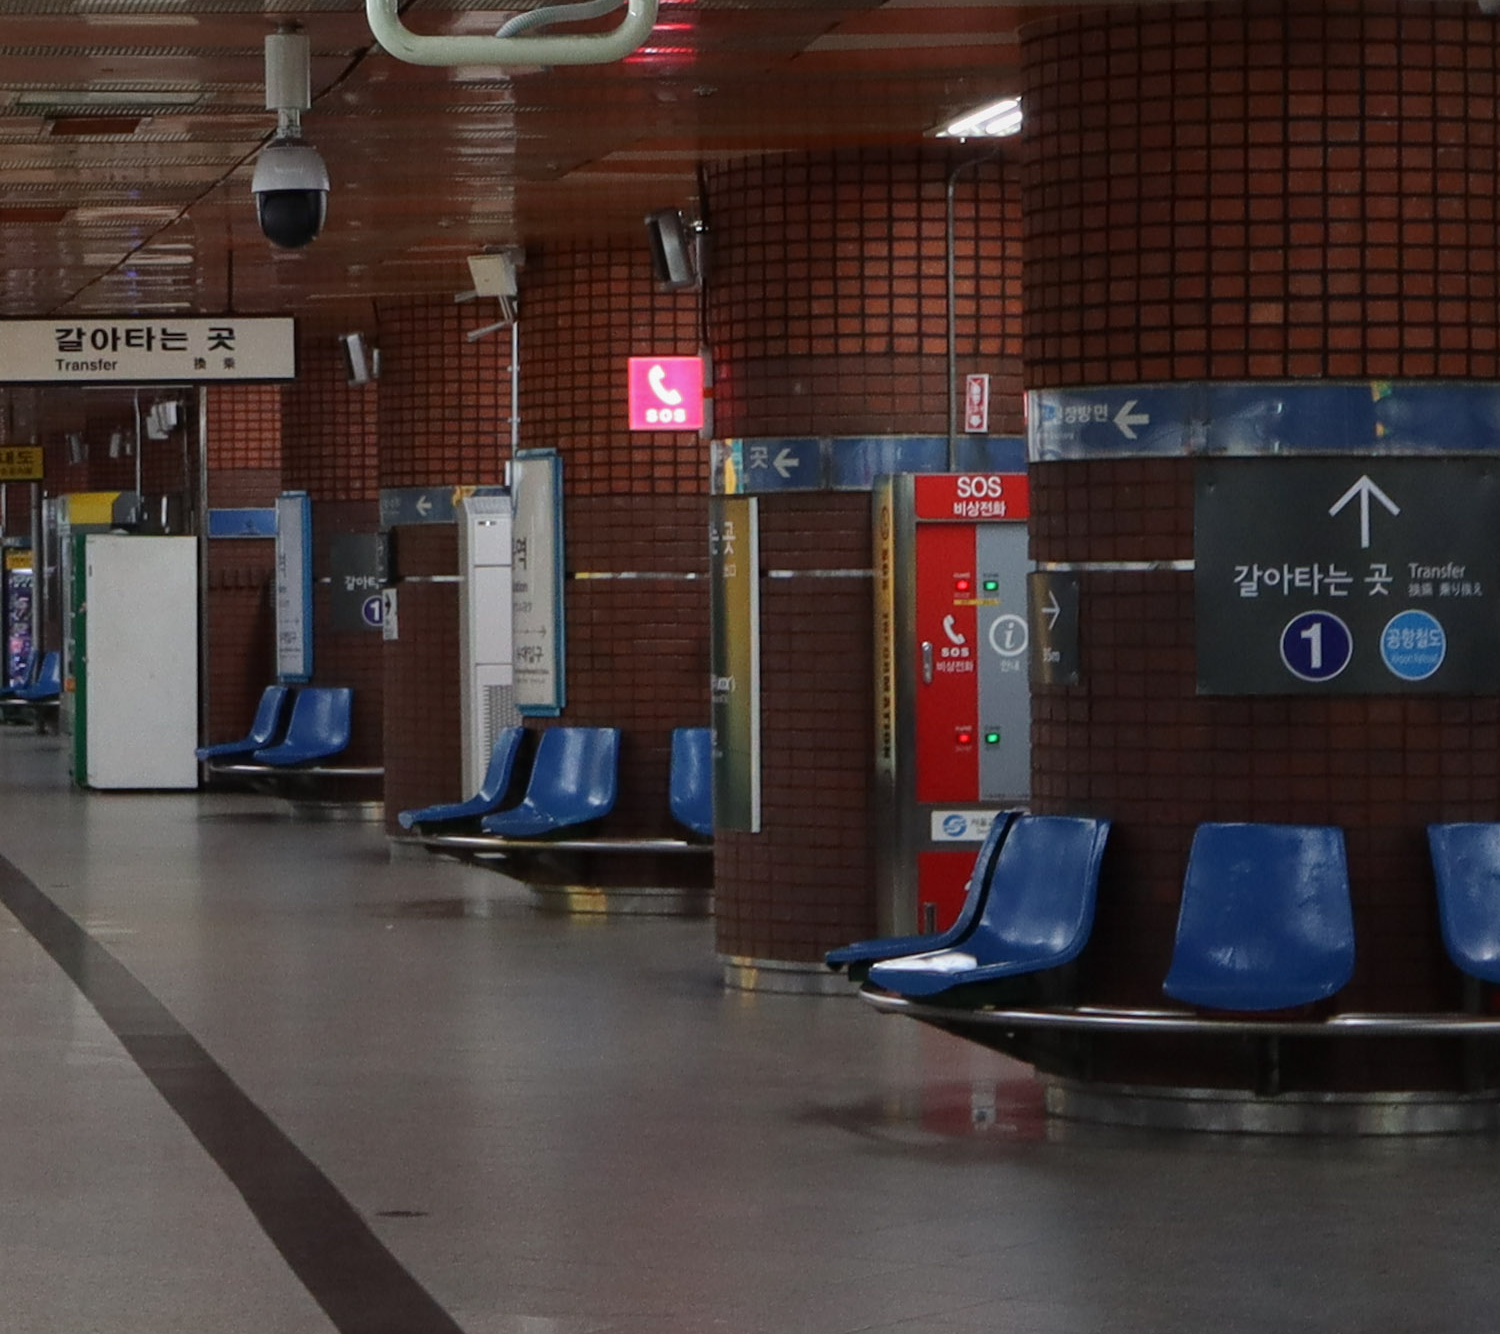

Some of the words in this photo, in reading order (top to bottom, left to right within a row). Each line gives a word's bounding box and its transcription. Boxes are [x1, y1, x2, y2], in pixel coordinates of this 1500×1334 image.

[55, 327, 189, 352] 갈아타는
[207, 327, 236, 351] 곳
[55, 358, 119, 371] Transfer
[645, 408, 687, 423] SOS
[750, 446, 769, 469] 곳
[957, 476, 1002, 498] SOS
[953, 501, 1006, 517] 비상전화
[1234, 563, 1353, 597] 갈아타는
[1364, 563, 1394, 596] 곳
[1408, 562, 1466, 579] Transfer
[370, 600, 380, 622] 1
[1300, 622, 1322, 668] 1
[1386, 628, 1441, 649] 공항철도
[941, 648, 970, 658] SOS
